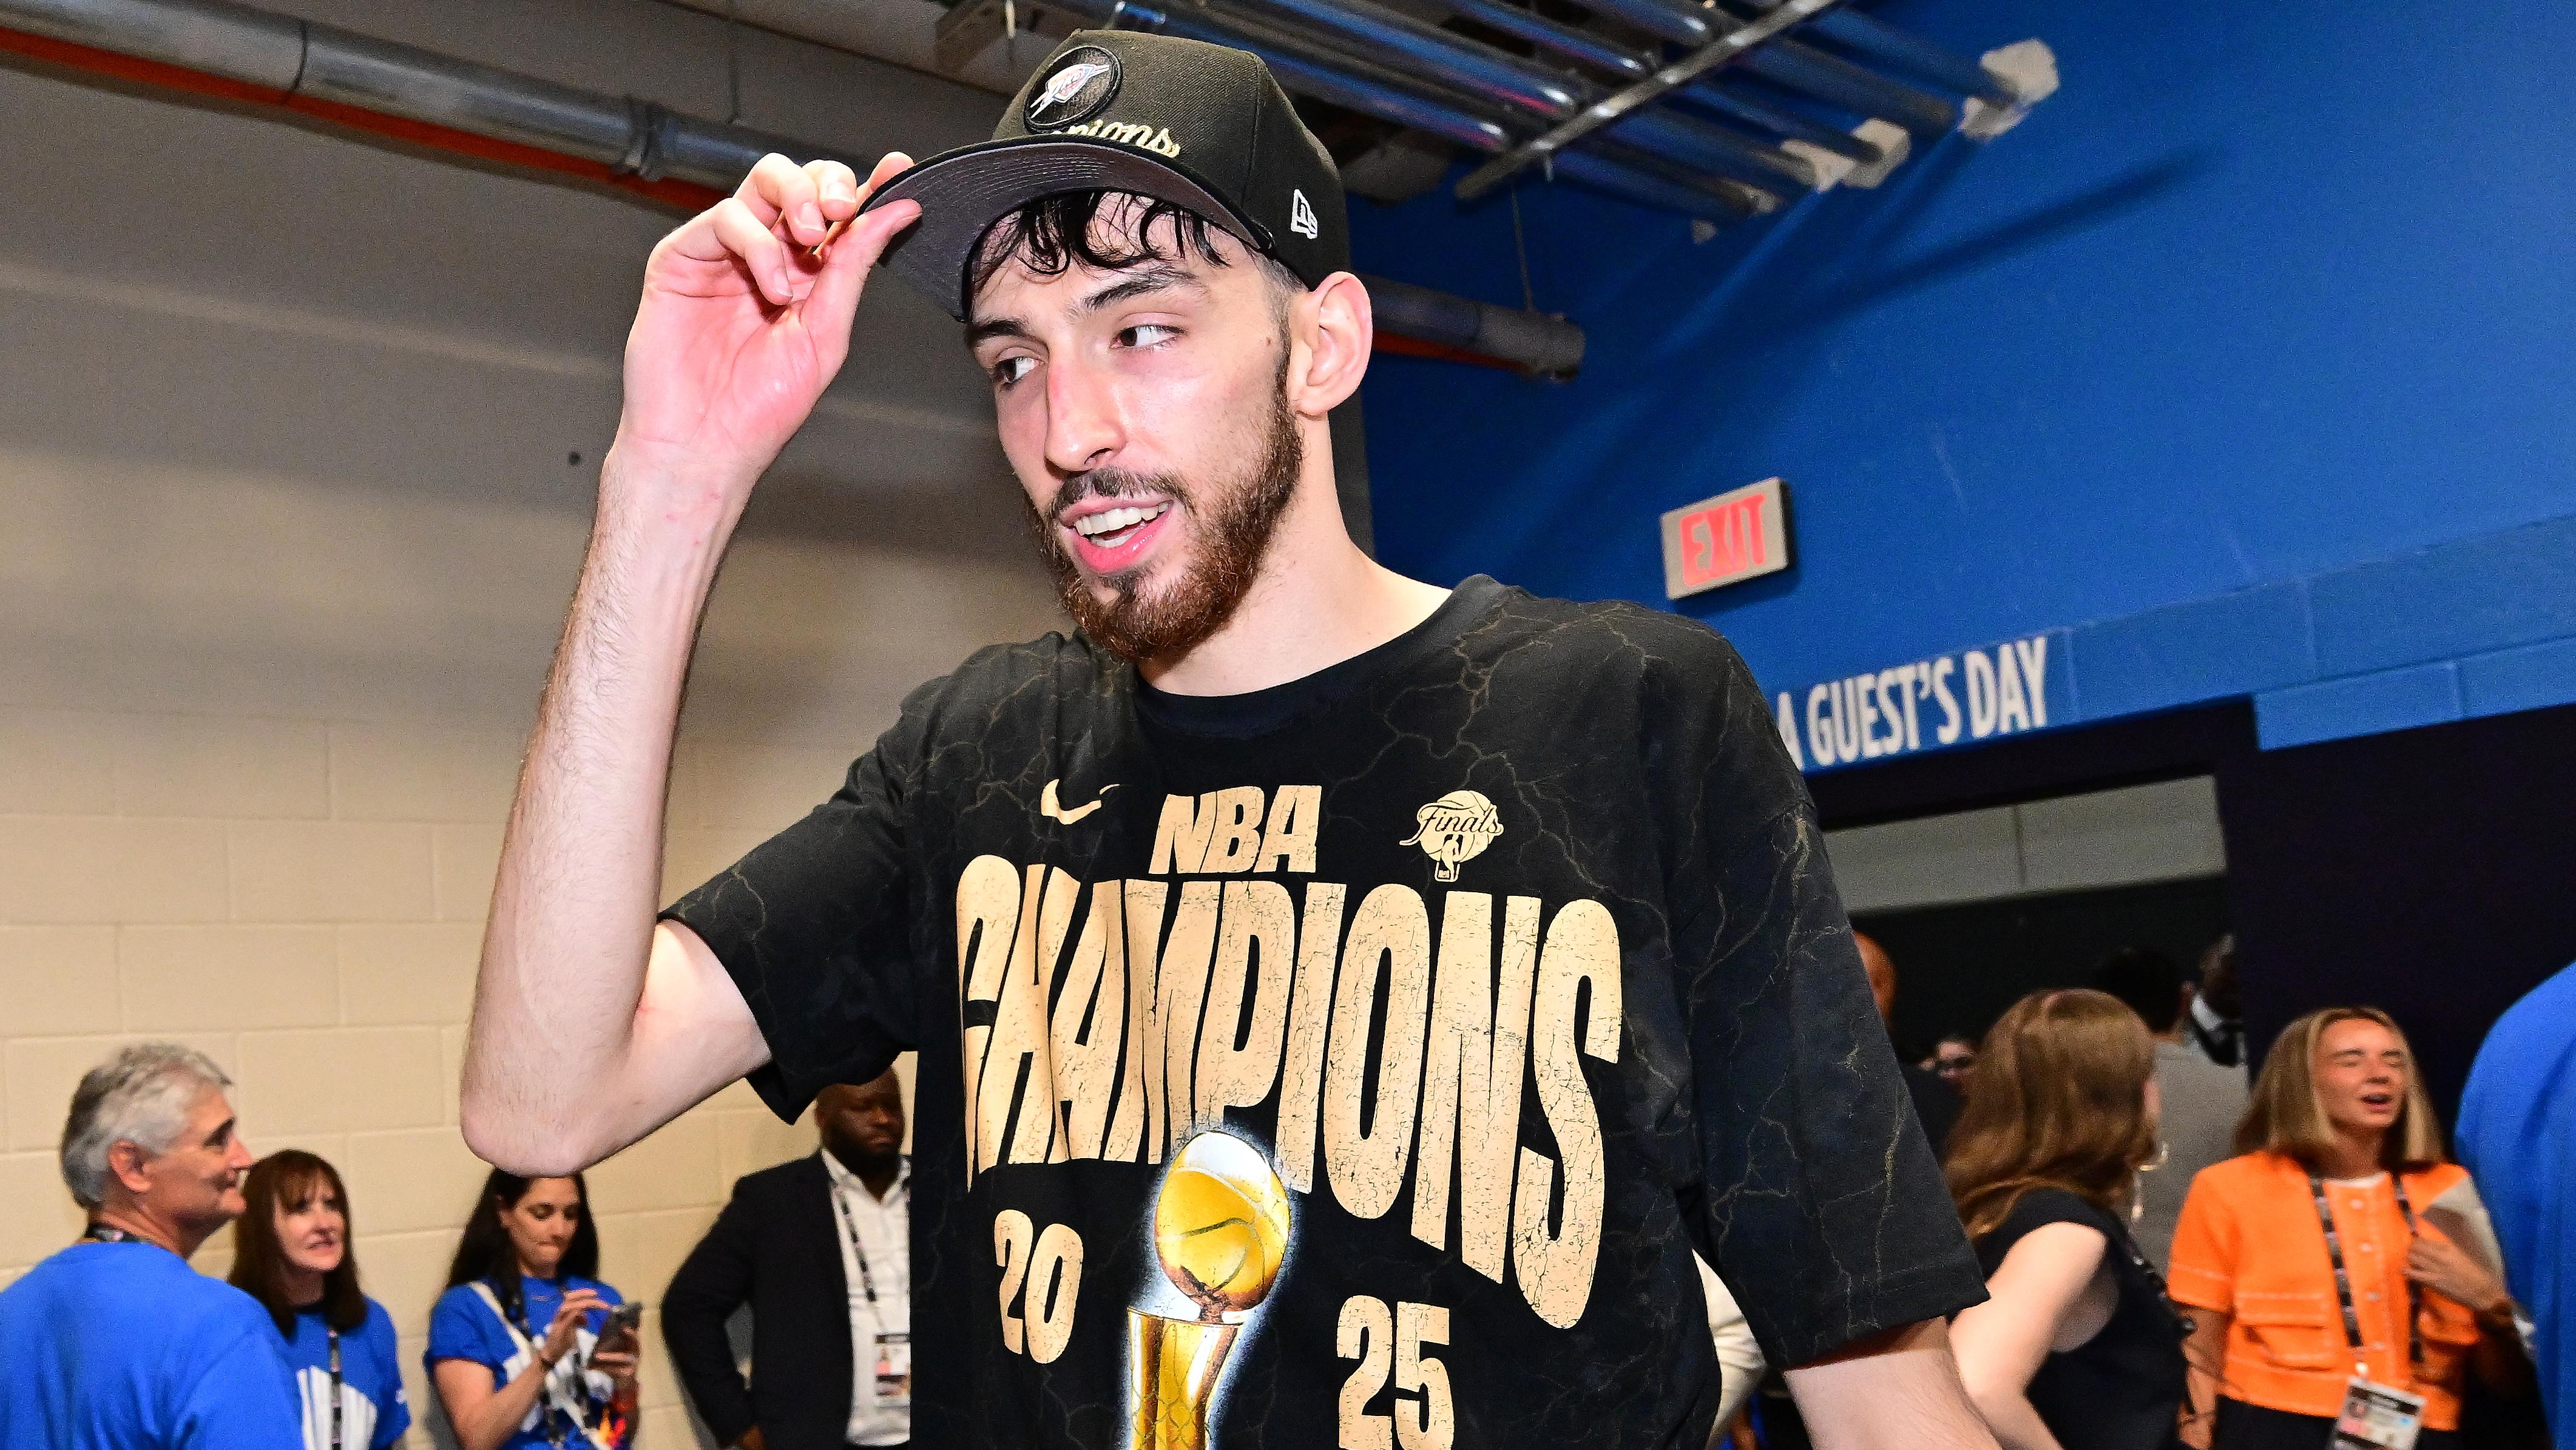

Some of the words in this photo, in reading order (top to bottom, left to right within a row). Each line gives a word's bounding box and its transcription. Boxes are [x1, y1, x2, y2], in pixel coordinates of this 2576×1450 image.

[1680, 492, 1765, 587] EXIT
[1806, 656, 1962, 767] GUEST'S
[1964, 636, 2048, 739] DAY
[1148, 784, 1322, 875] NBA
[1401, 804, 1503, 845] Finals
[956, 853, 1623, 1329] CHAMPIONS
[994, 1209, 1084, 1364] 20
[1336, 1295, 1455, 1450] 25
